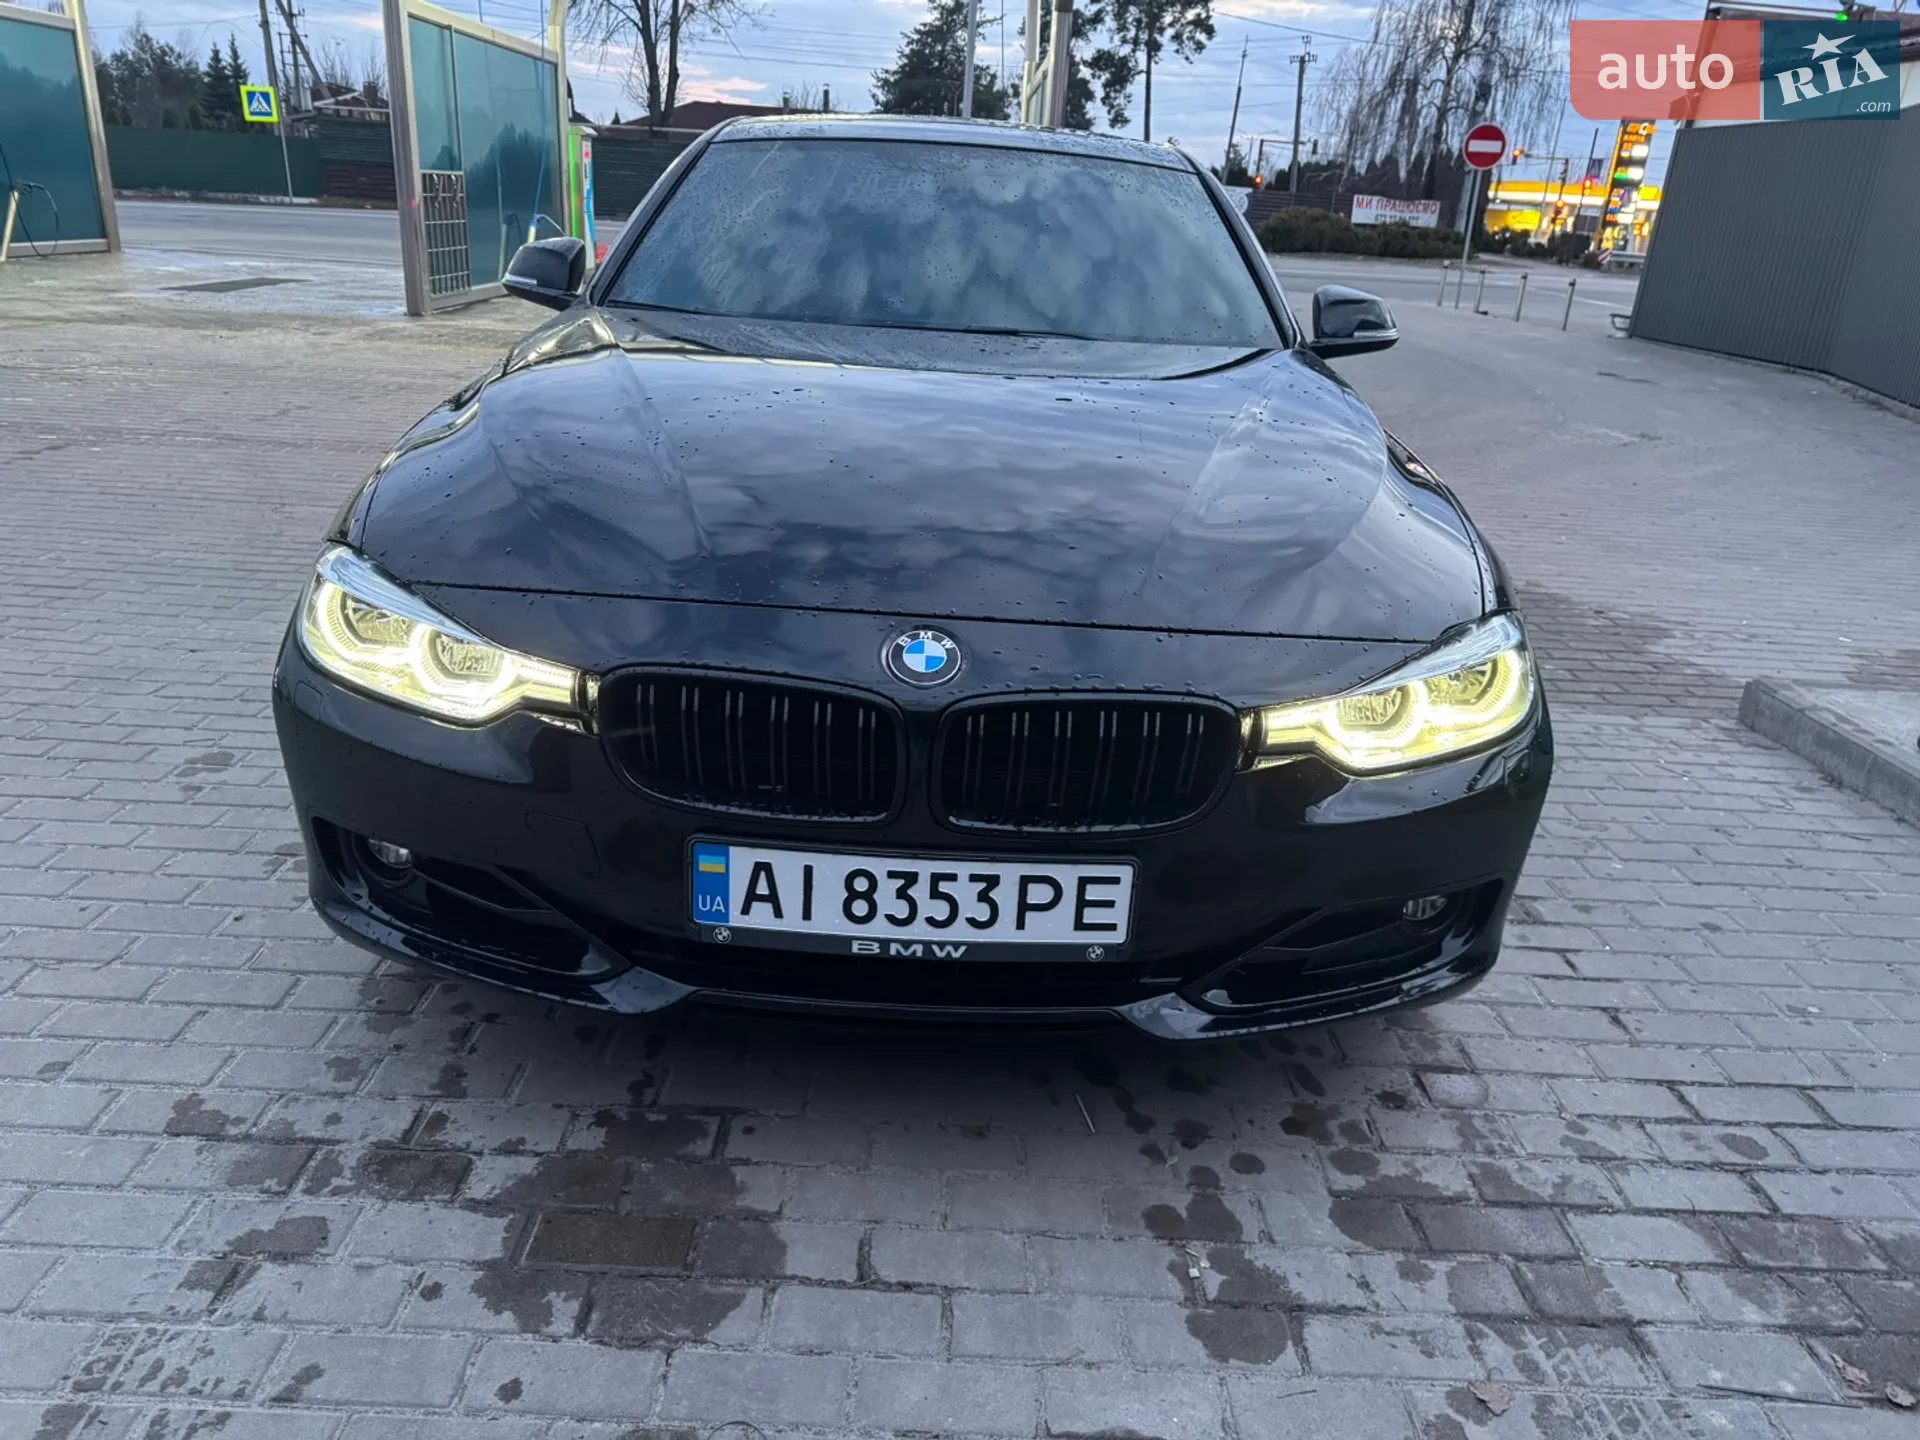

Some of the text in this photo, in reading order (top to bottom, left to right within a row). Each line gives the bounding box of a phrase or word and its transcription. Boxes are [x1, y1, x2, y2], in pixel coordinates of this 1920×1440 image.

[1355, 196, 1437, 215] МИ ПРАЦЮЄМО
[897, 630, 955, 649] BMW
[739, 861, 814, 921] AI
[698, 894, 726, 913] UA
[851, 940, 968, 958] BMW
